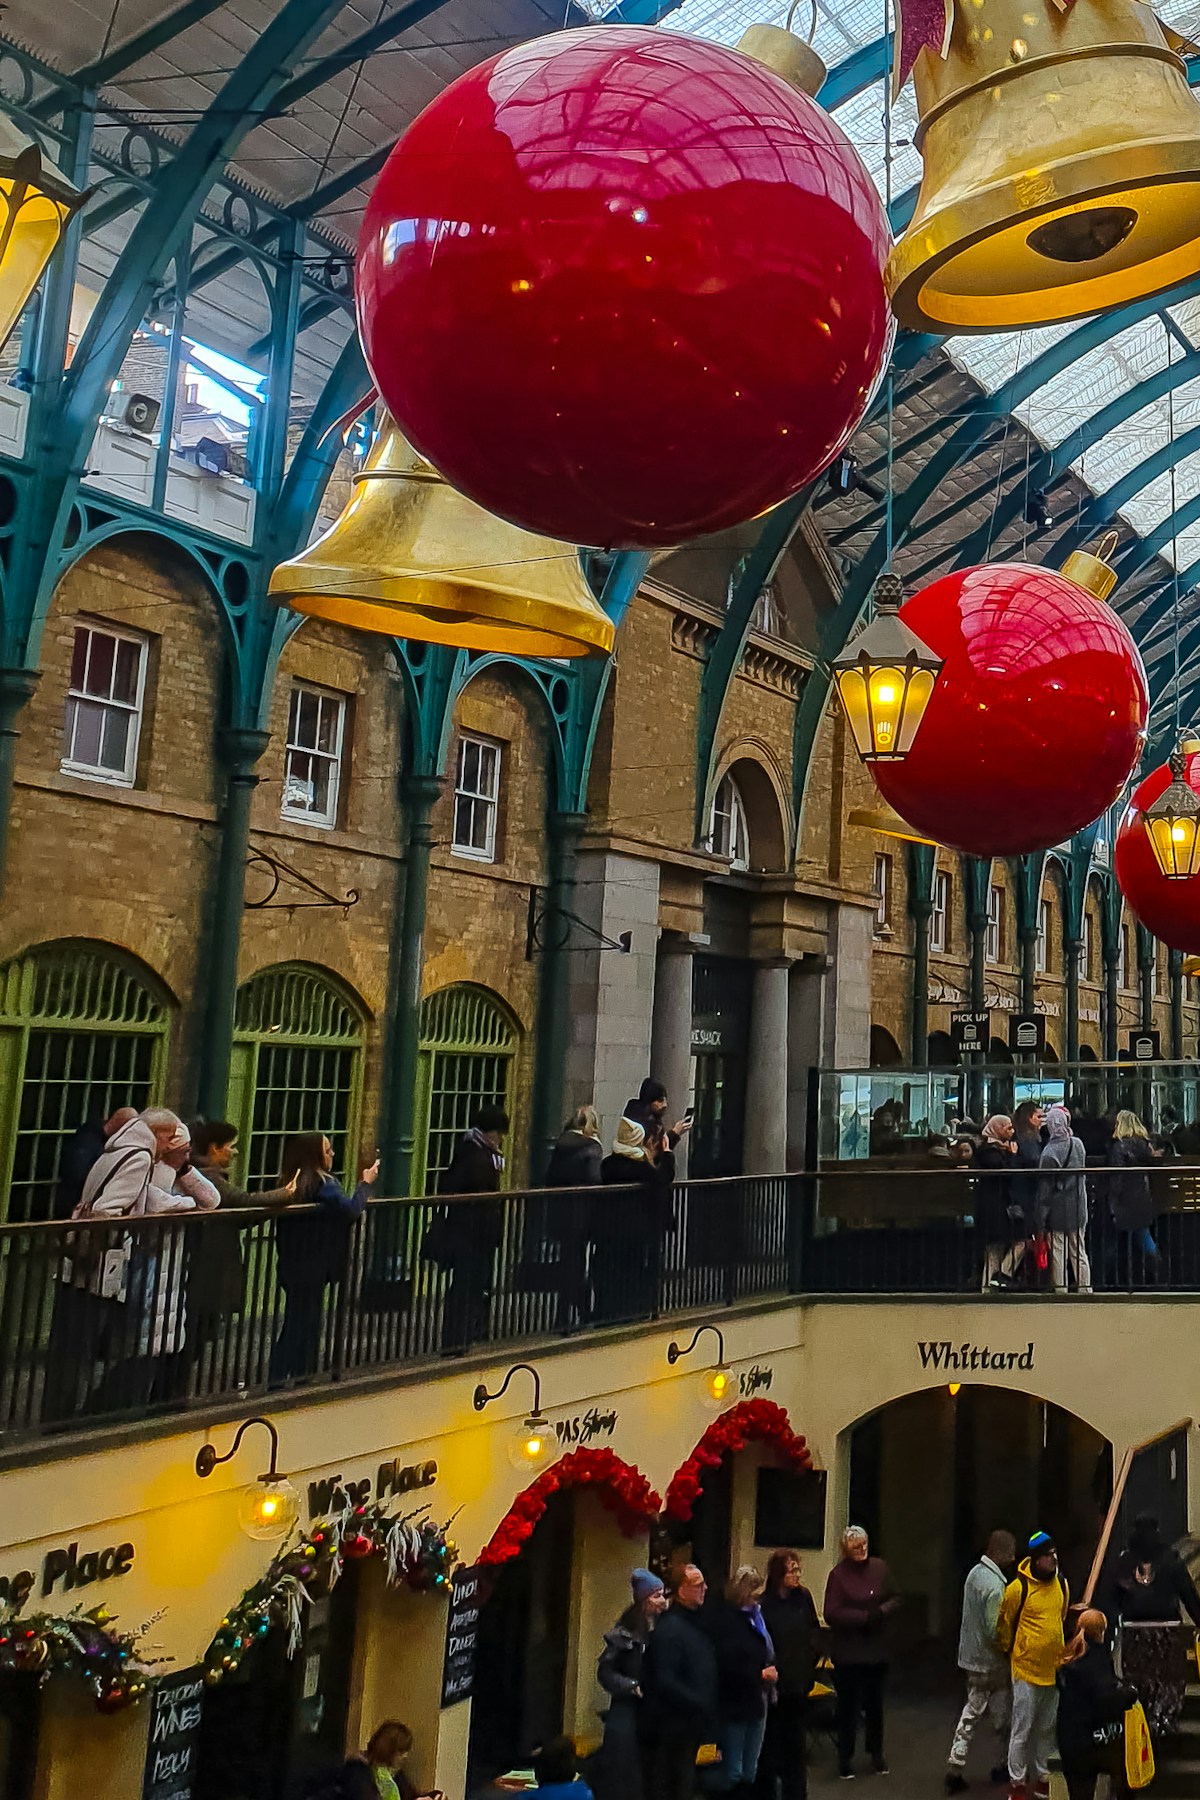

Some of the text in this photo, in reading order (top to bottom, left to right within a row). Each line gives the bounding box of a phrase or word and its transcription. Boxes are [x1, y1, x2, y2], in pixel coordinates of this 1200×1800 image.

[953, 1013, 988, 1023] PICK UP
[959, 1042, 981, 1050] HERE
[917, 1341, 1035, 1370] Whittard
[376, 1458, 438, 1501] Place
[41, 1542, 135, 1597] Place
